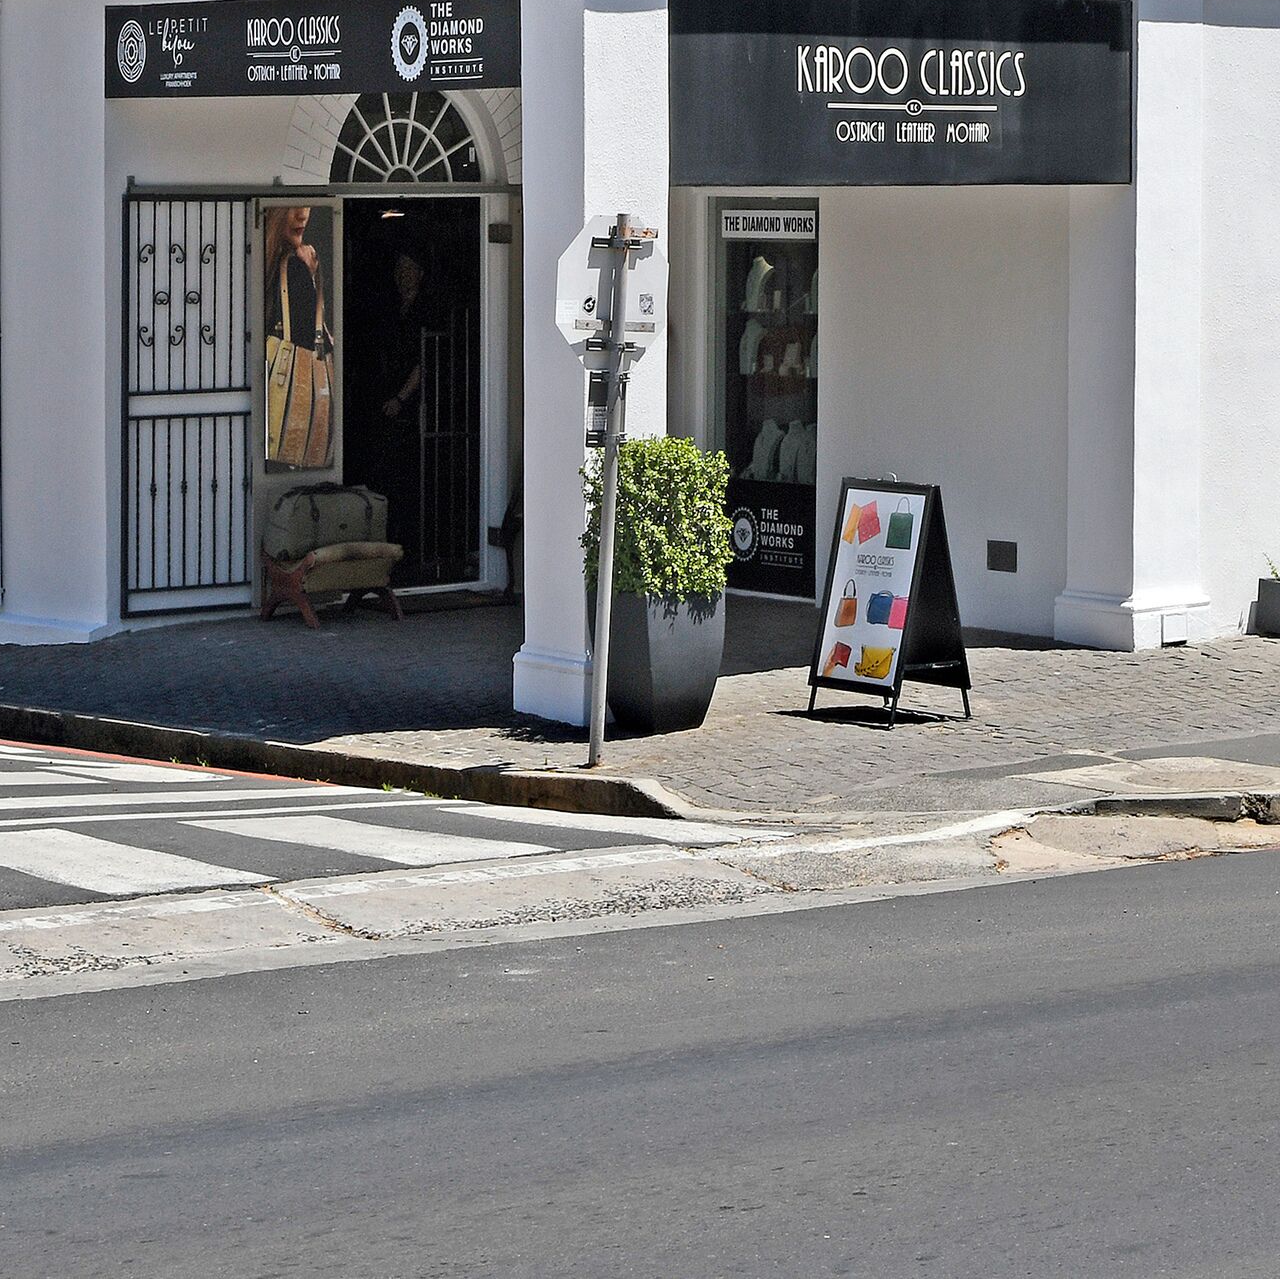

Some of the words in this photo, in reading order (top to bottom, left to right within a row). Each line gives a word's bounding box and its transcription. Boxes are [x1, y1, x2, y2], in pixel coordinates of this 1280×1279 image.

[430, 2, 453, 18] THE
[149, 20, 163, 35] LE
[171, 18, 208, 34] PETIT
[247, 17, 294, 47] KAROO
[297, 15, 340, 45] CLASSICS
[430, 18, 484, 37] DIAMOND
[162, 18, 195, 69] bijou
[430, 38, 472, 55] WORKS
[247, 65, 276, 81] OSTRICH
[281, 64, 308, 81] LEATHER
[314, 63, 341, 80] MOHAIR
[430, 63, 483, 75] INSTITUTE
[796, 45, 909, 95] KAROO
[920, 49, 1027, 97] CLASSICS
[836, 120, 885, 142] OSTRICH
[896, 121, 936, 143] LEATHER
[946, 122, 990, 143] MOHAIR
[724, 216, 740, 232] THE
[741, 216, 780, 232] DIAMOND
[782, 216, 814, 232] WORKS
[761, 508, 779, 520] THE
[760, 521, 803, 536] DIAMOND
[760, 535, 794, 549] WORKS
